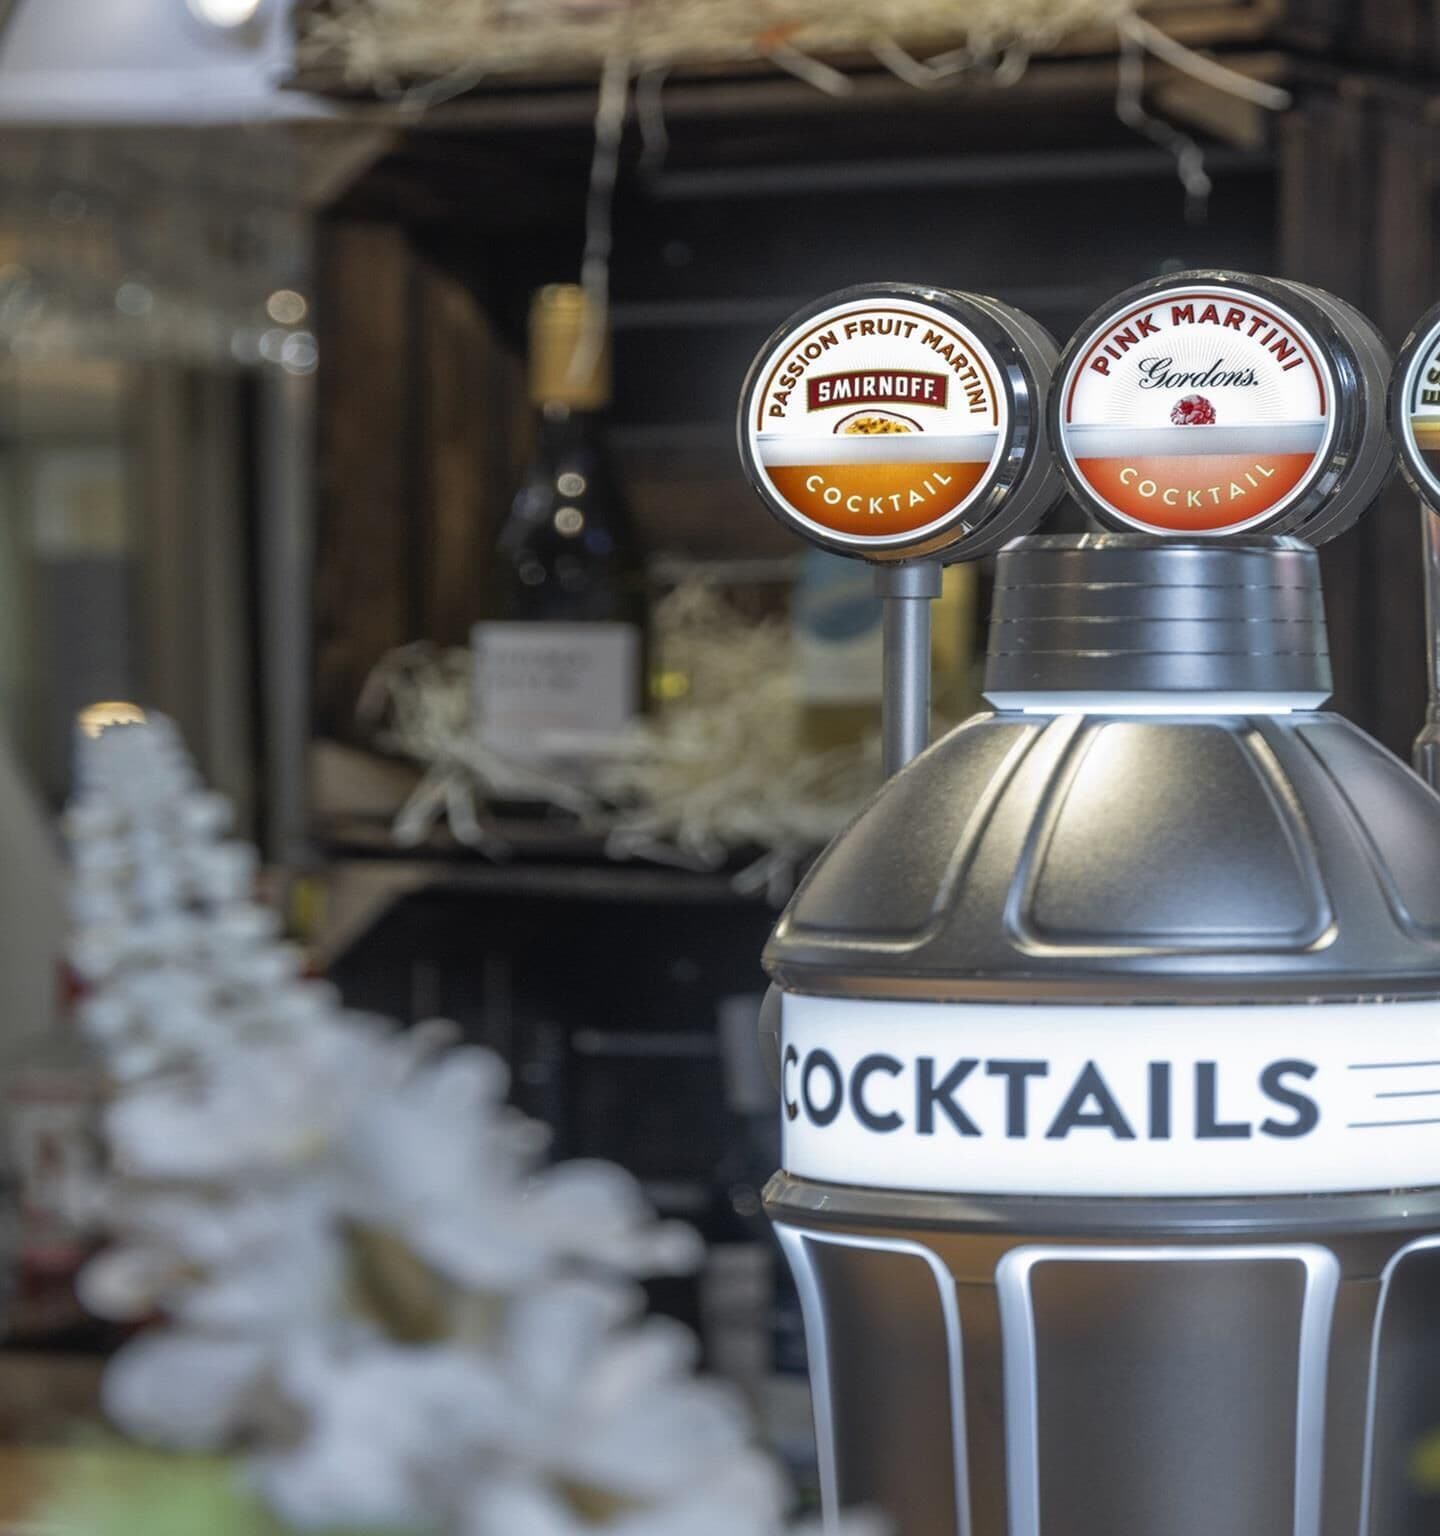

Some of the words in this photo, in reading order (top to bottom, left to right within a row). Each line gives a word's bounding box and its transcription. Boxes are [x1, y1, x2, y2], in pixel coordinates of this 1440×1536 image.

[769, 330, 839, 417] PASSION
[844, 319, 918, 340] FRUIT
[921, 329, 987, 413] MARTINI
[1090, 313, 1160, 376] PINK
[1172, 304, 1303, 371] MARTINI
[806, 472, 952, 514] COCKTAIL
[1120, 464, 1274, 507] COCKTAIL
[782, 1043, 1320, 1139] COCKTAILS
